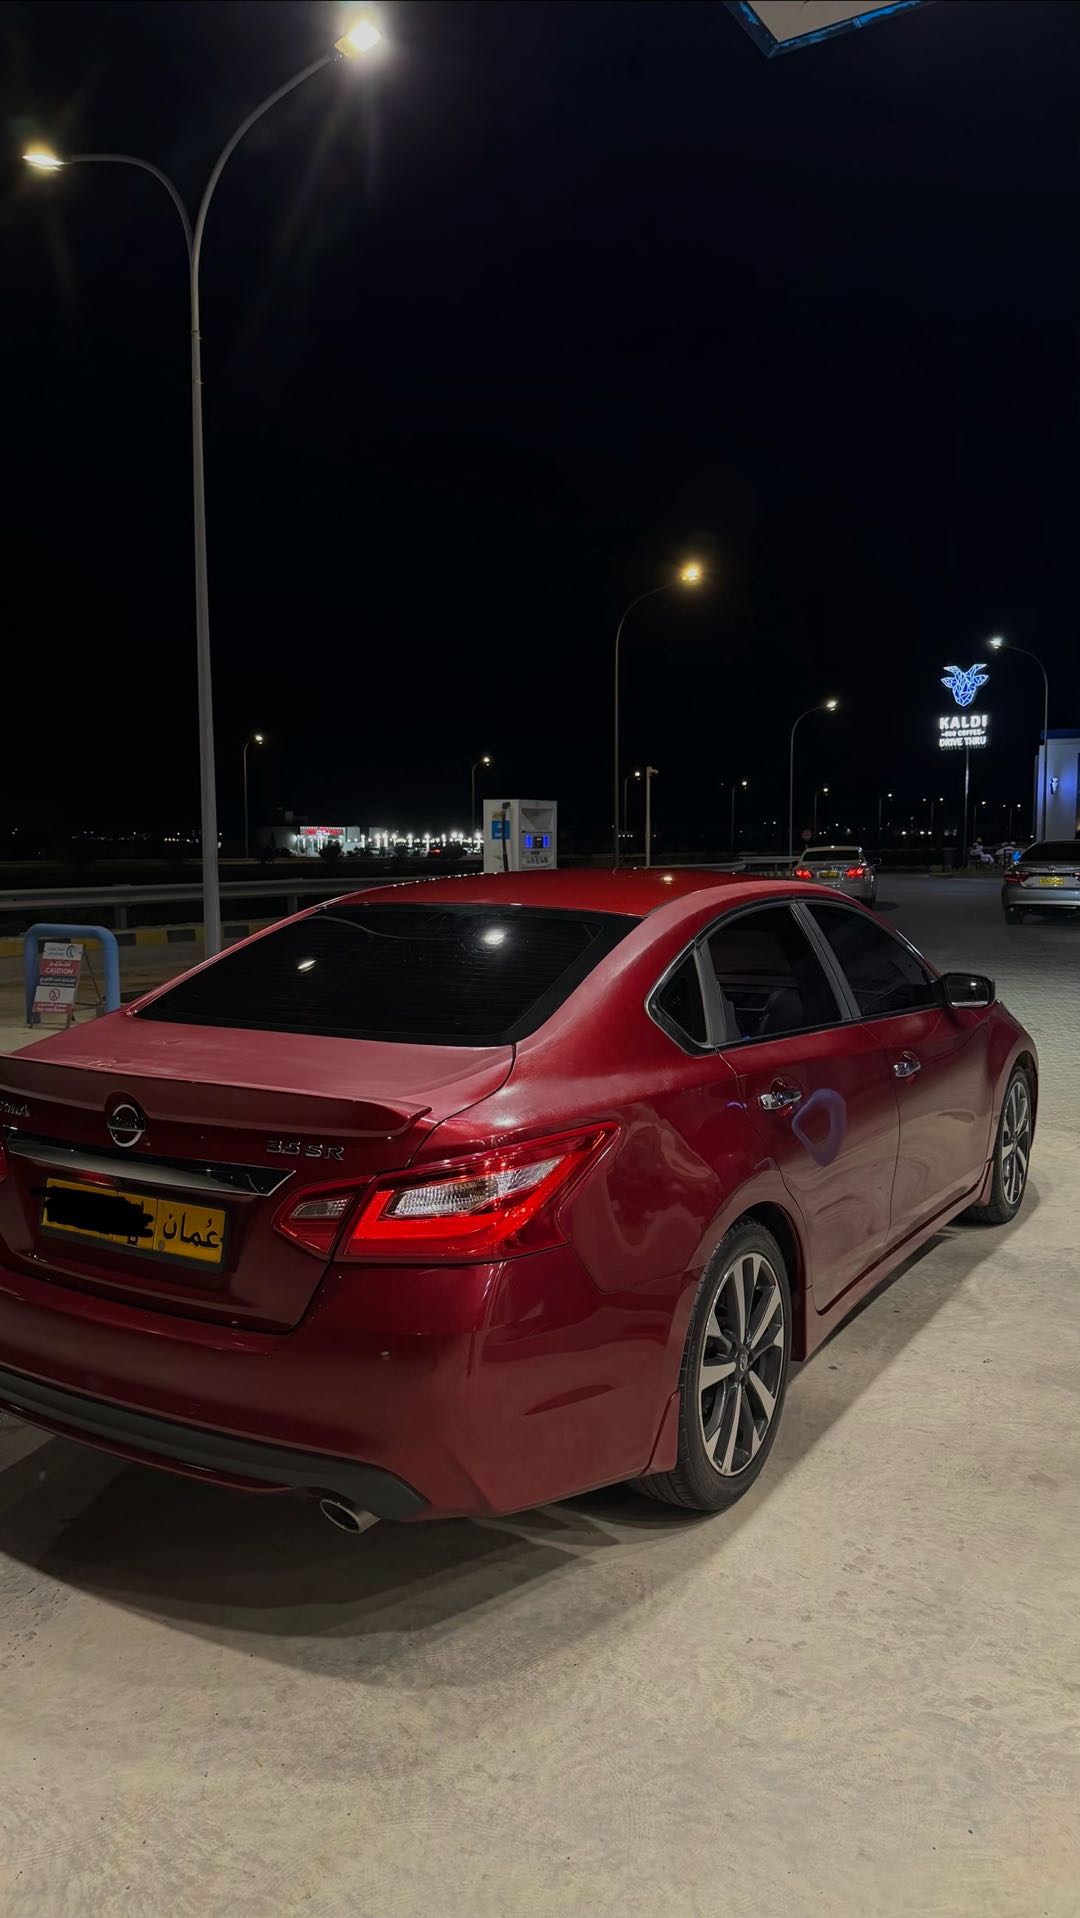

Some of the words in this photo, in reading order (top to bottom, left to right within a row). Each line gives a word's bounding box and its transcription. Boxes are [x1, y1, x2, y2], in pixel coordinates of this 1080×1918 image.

[940, 715, 987, 729] KALDI
[939, 738, 963, 747] DRIVE
[964, 736, 987, 745] THRU
[45, 967, 73, 975] CAUTION
[305, 1144, 345, 1161] SR
